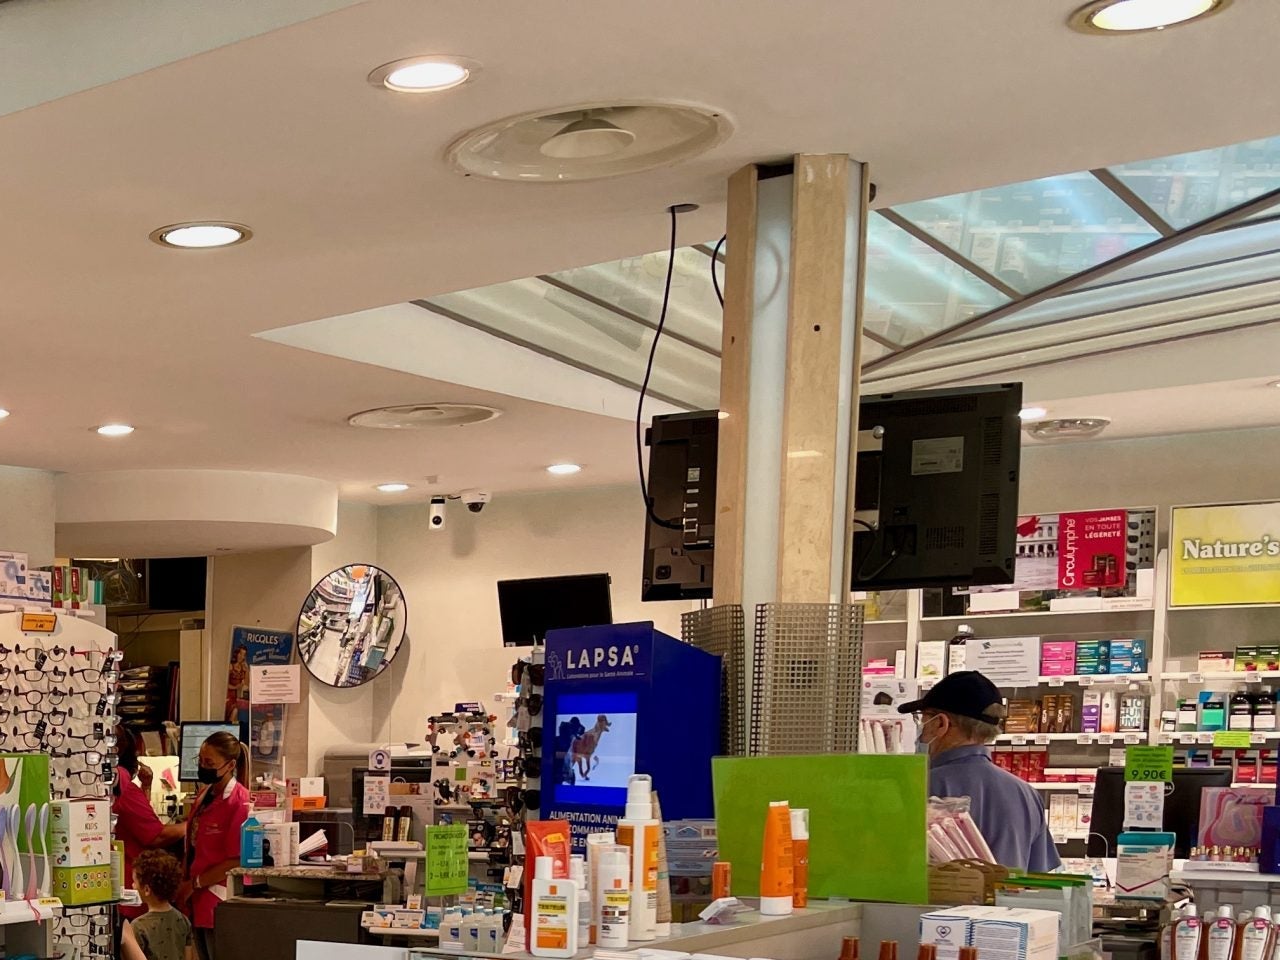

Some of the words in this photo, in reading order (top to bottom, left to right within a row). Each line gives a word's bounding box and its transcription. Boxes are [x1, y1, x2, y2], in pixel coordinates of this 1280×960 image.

[1098, 515, 1122, 523] JAMBES
[1097, 523, 1121, 531] TOUTE
[1182, 535, 1280, 561] Nature's
[566, 645, 634, 669] LAPSA
[549, 810, 601, 824] ALIMENTATION
